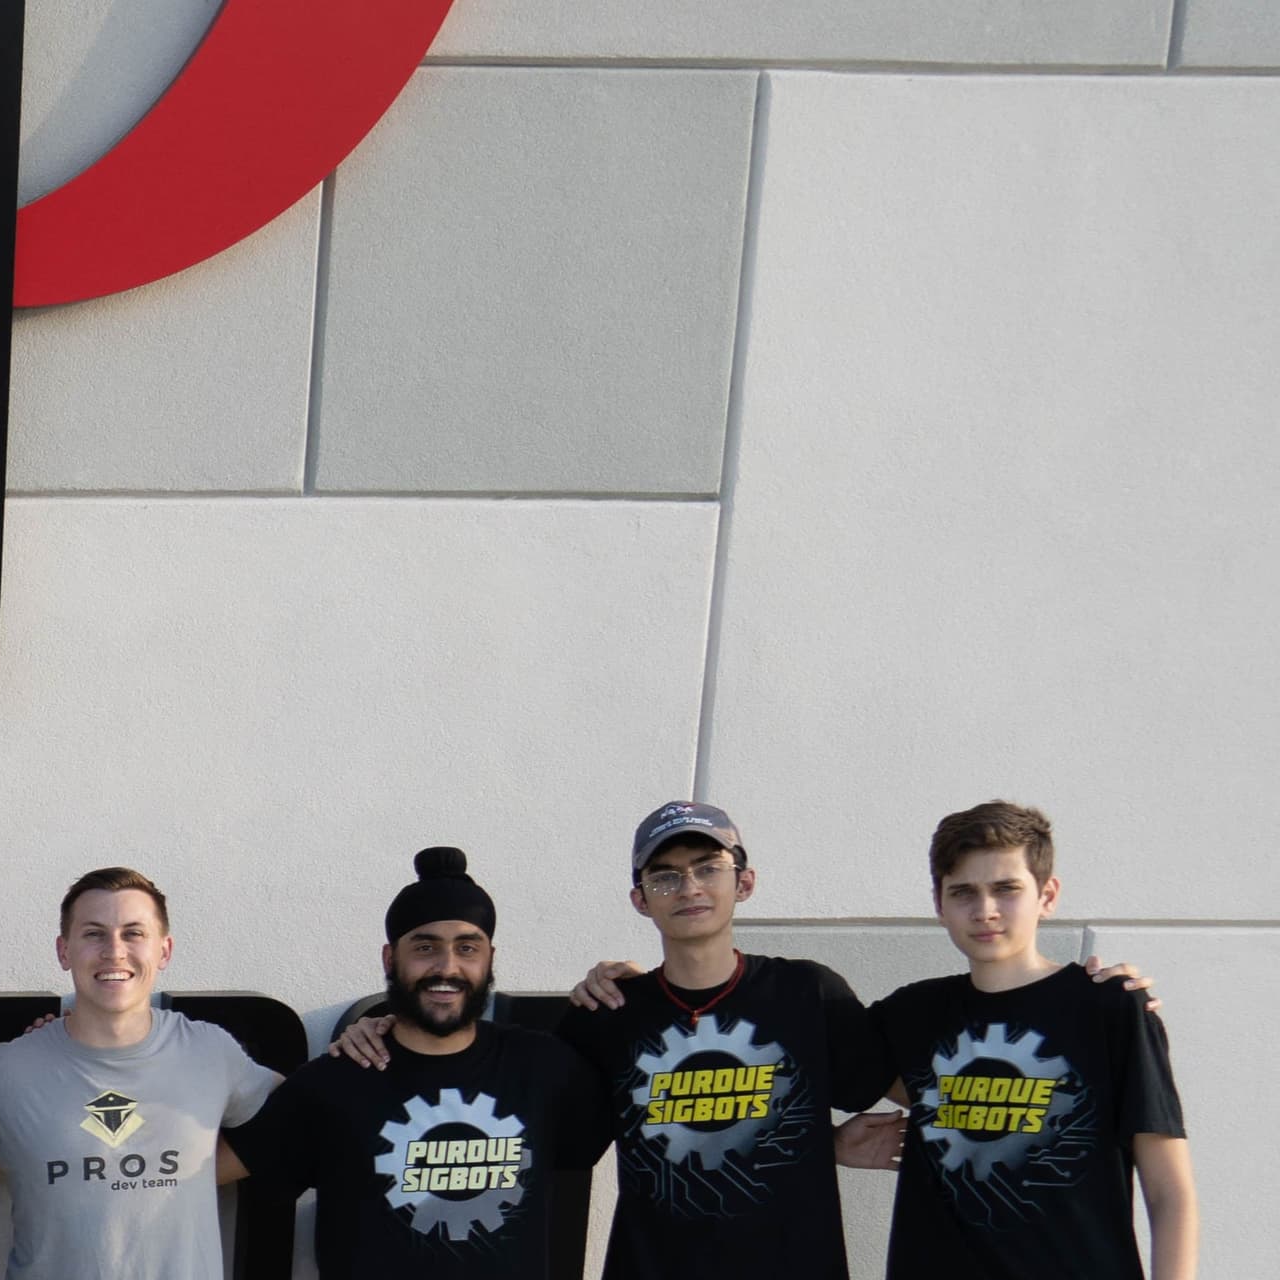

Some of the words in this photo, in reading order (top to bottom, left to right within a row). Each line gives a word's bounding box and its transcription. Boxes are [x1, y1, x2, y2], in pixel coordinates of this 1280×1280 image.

[650, 1065, 775, 1098] PURDUE
[940, 1076, 1056, 1105] PURDUE
[646, 1094, 771, 1125] SIGBOTS
[932, 1104, 1047, 1133] SIGBOTS
[406, 1137, 522, 1165] PURDUE
[46, 1150, 180, 1185] PROS
[402, 1164, 520, 1192] SIGBOTS
[111, 1181, 137, 1191] dev
[142, 1178, 177, 1188] team
